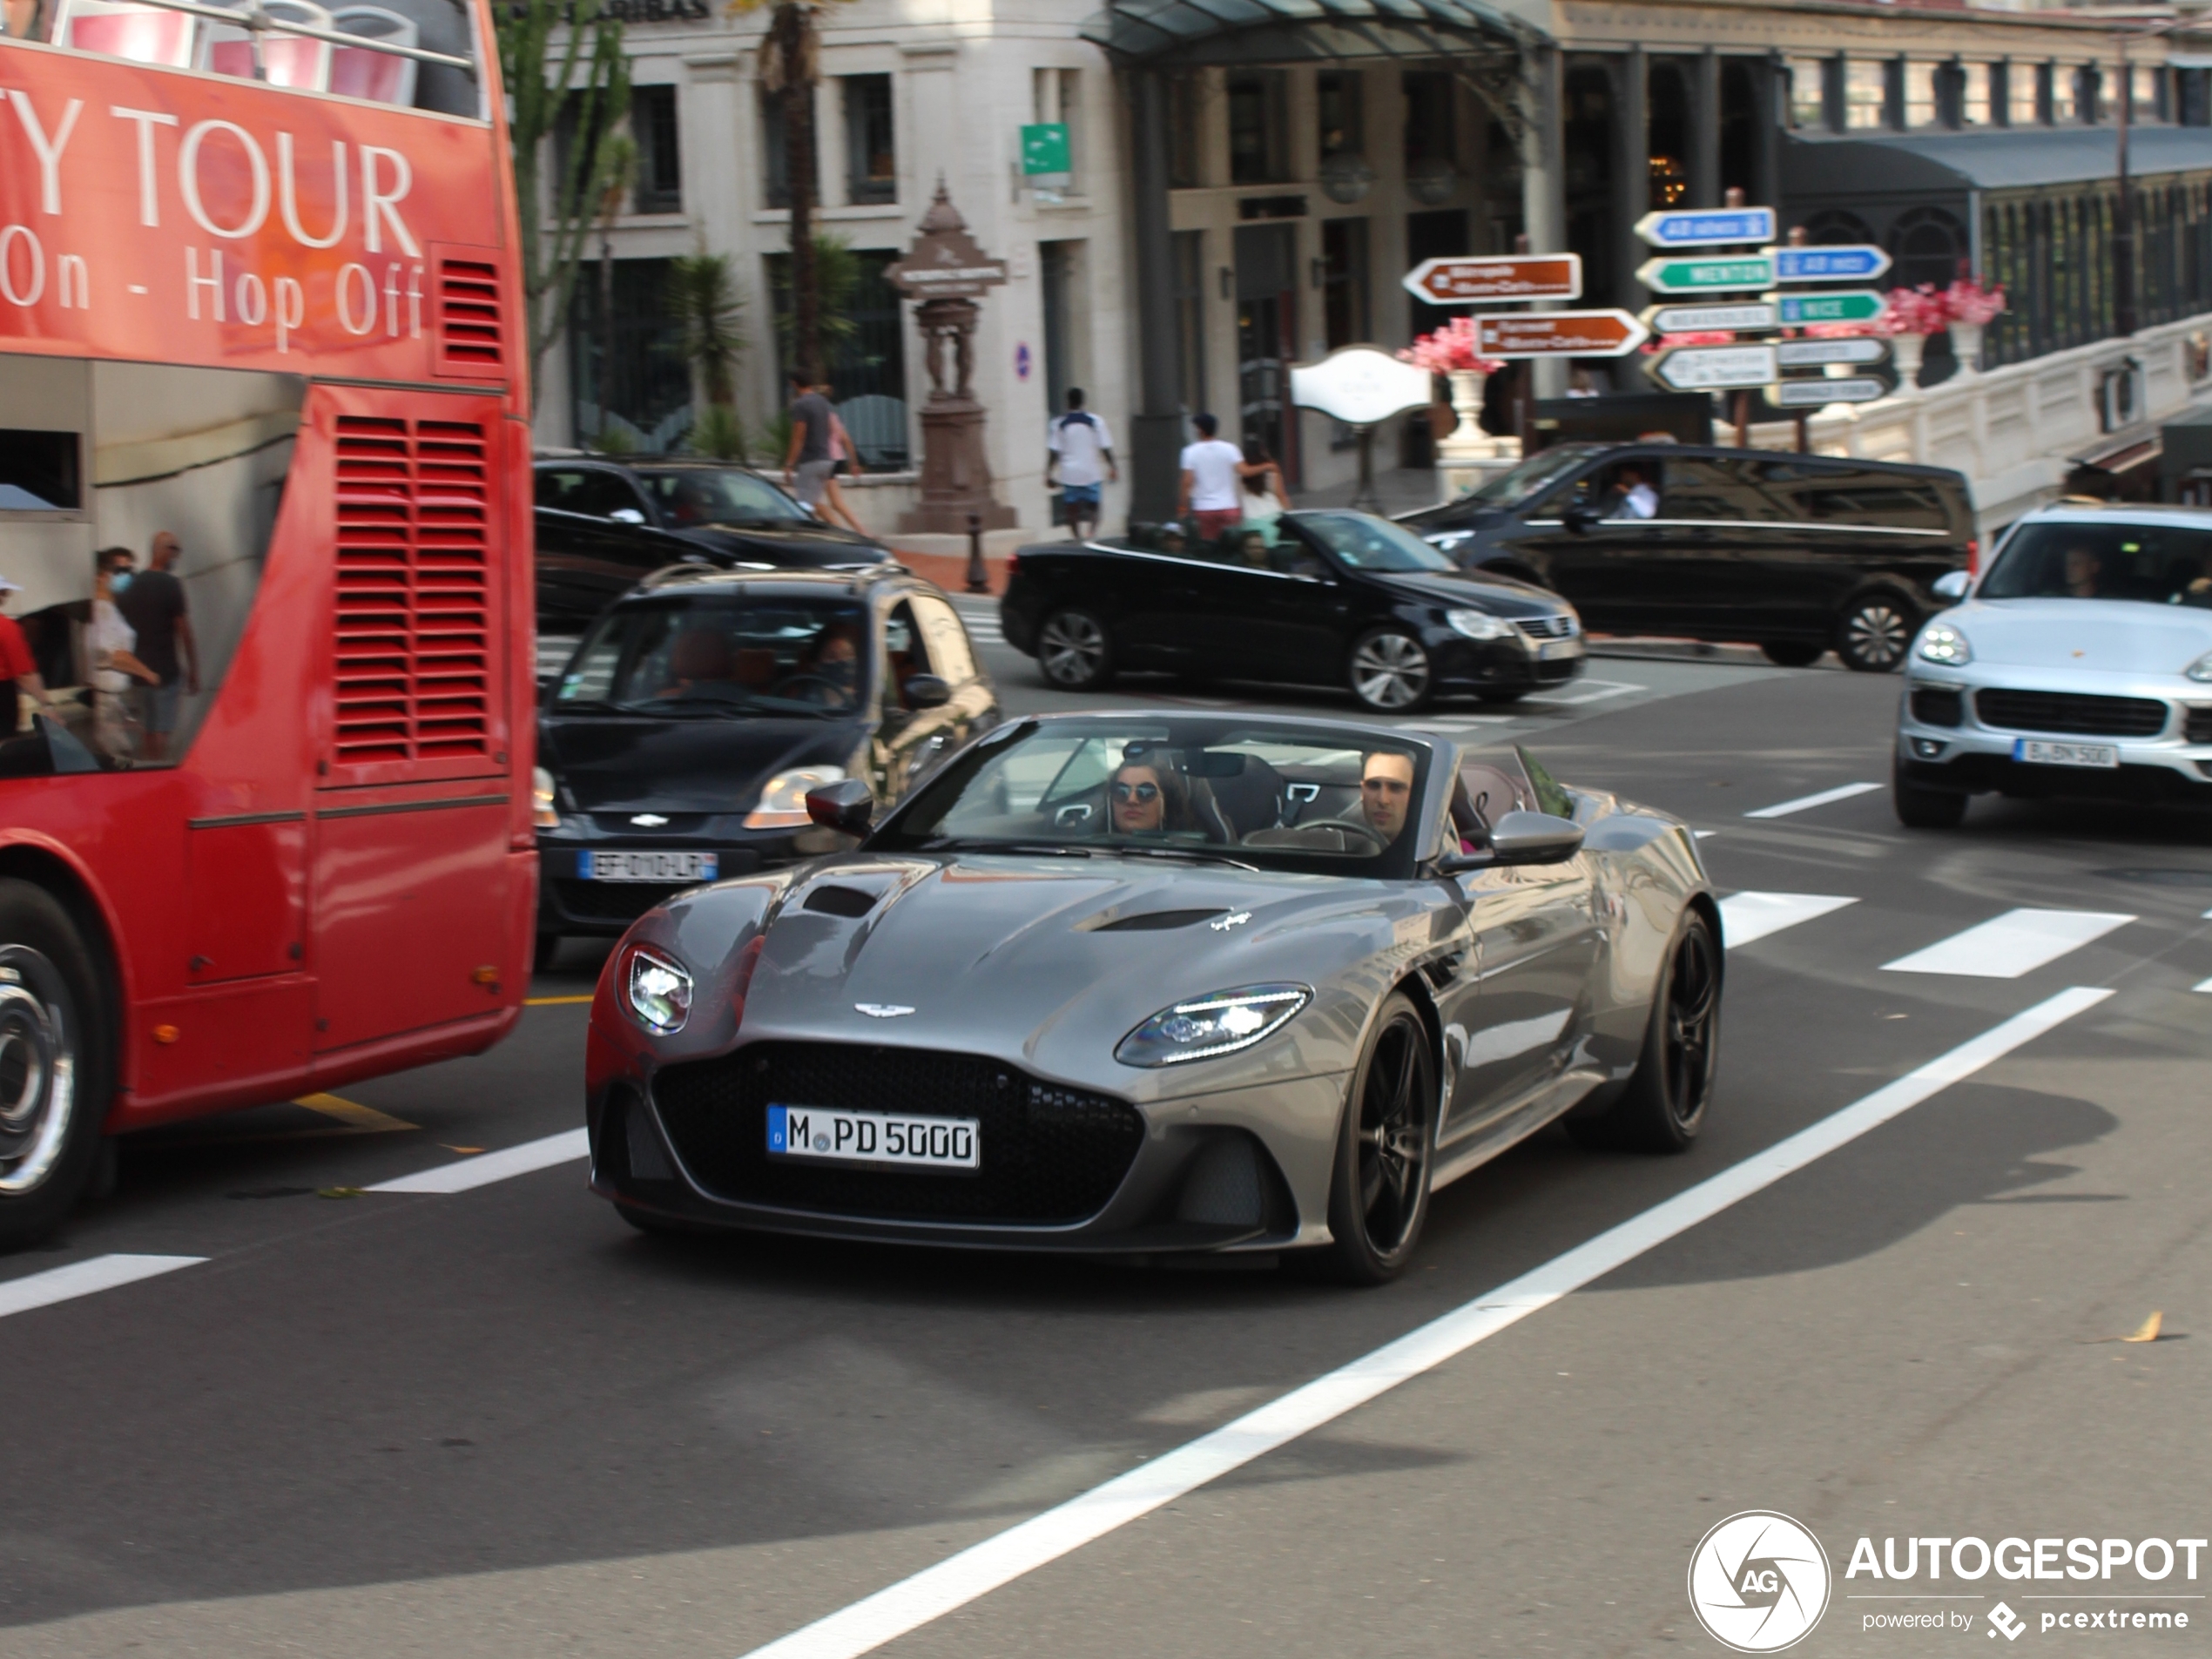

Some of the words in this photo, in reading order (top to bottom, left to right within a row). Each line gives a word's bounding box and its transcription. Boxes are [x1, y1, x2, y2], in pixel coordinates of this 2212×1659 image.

[0, 89, 84, 216] Y
[110, 105, 423, 258] TOUR
[0, 224, 89, 310] On
[185, 246, 304, 354] Hop
[335, 262, 424, 340] Off
[1689, 264, 1768, 283] MENTON
[1804, 300, 1844, 318] NICE
[789, 1114, 810, 1149] M
[833, 1118, 877, 1153] PD
[886, 1123, 973, 1160] 5000
